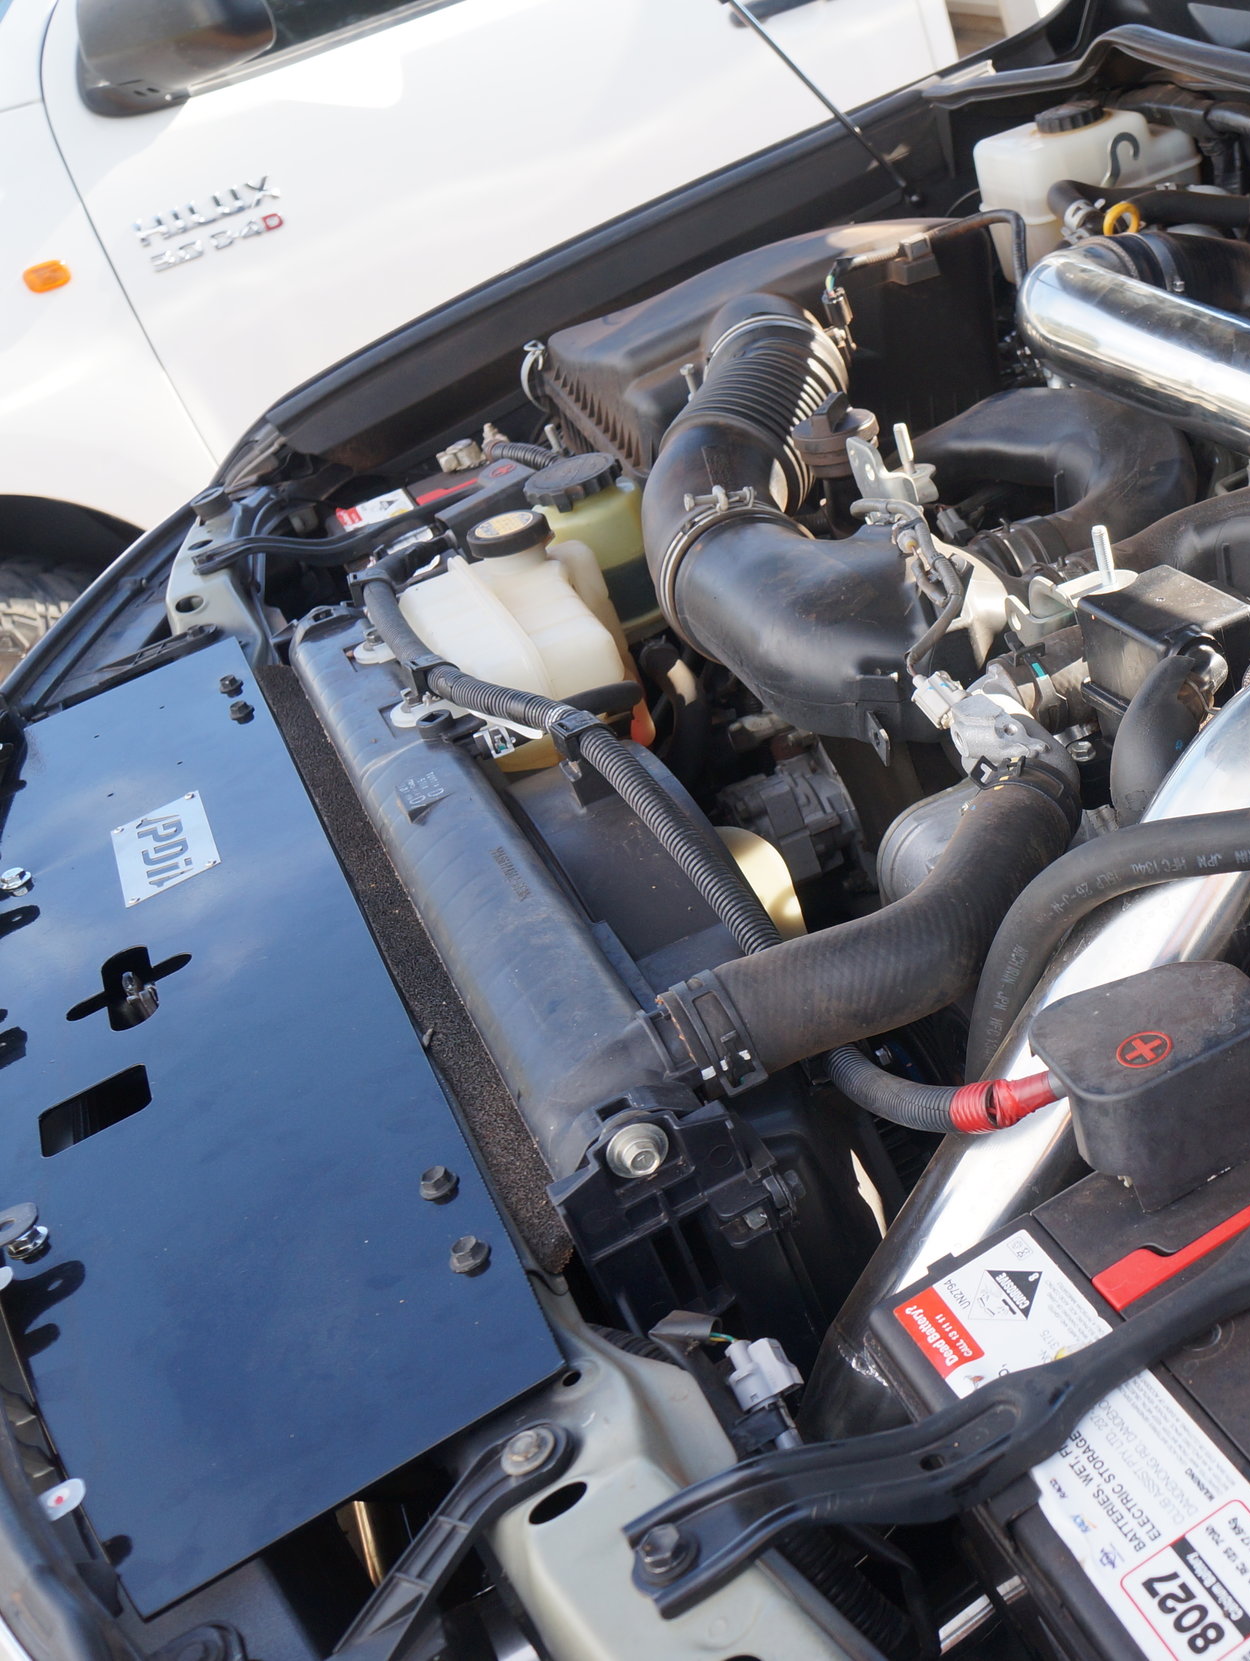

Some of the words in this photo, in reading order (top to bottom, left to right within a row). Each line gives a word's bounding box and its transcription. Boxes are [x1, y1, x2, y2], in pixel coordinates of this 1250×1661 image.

[132, 175, 281, 247] HILUX
[1196, 852, 1222, 866] JPN
[995, 1271, 1030, 1309] CORROSIVE
[1028, 1271, 1039, 1281] 8
[943, 1277, 971, 1309] UN2794
[904, 1301, 940, 1343] Battery?
[935, 1312, 946, 1323] 11
[942, 1321, 953, 1332] 11
[948, 1329, 960, 1340] 13
[955, 1338, 973, 1357] CALL
[1039, 1328, 1059, 1349] 3175
[932, 1338, 958, 1366] Dead
[1067, 1455, 1094, 1485] WET,
[1068, 1429, 1115, 1484] STORAGE
[1115, 1446, 1138, 1468] PTY
[1089, 1483, 1146, 1552] BATTERIES,
[1110, 1482, 1161, 1541] ELECTRIC
[1235, 1561, 1250, 1575] RC
[1140, 1562, 1227, 1656] 8027
